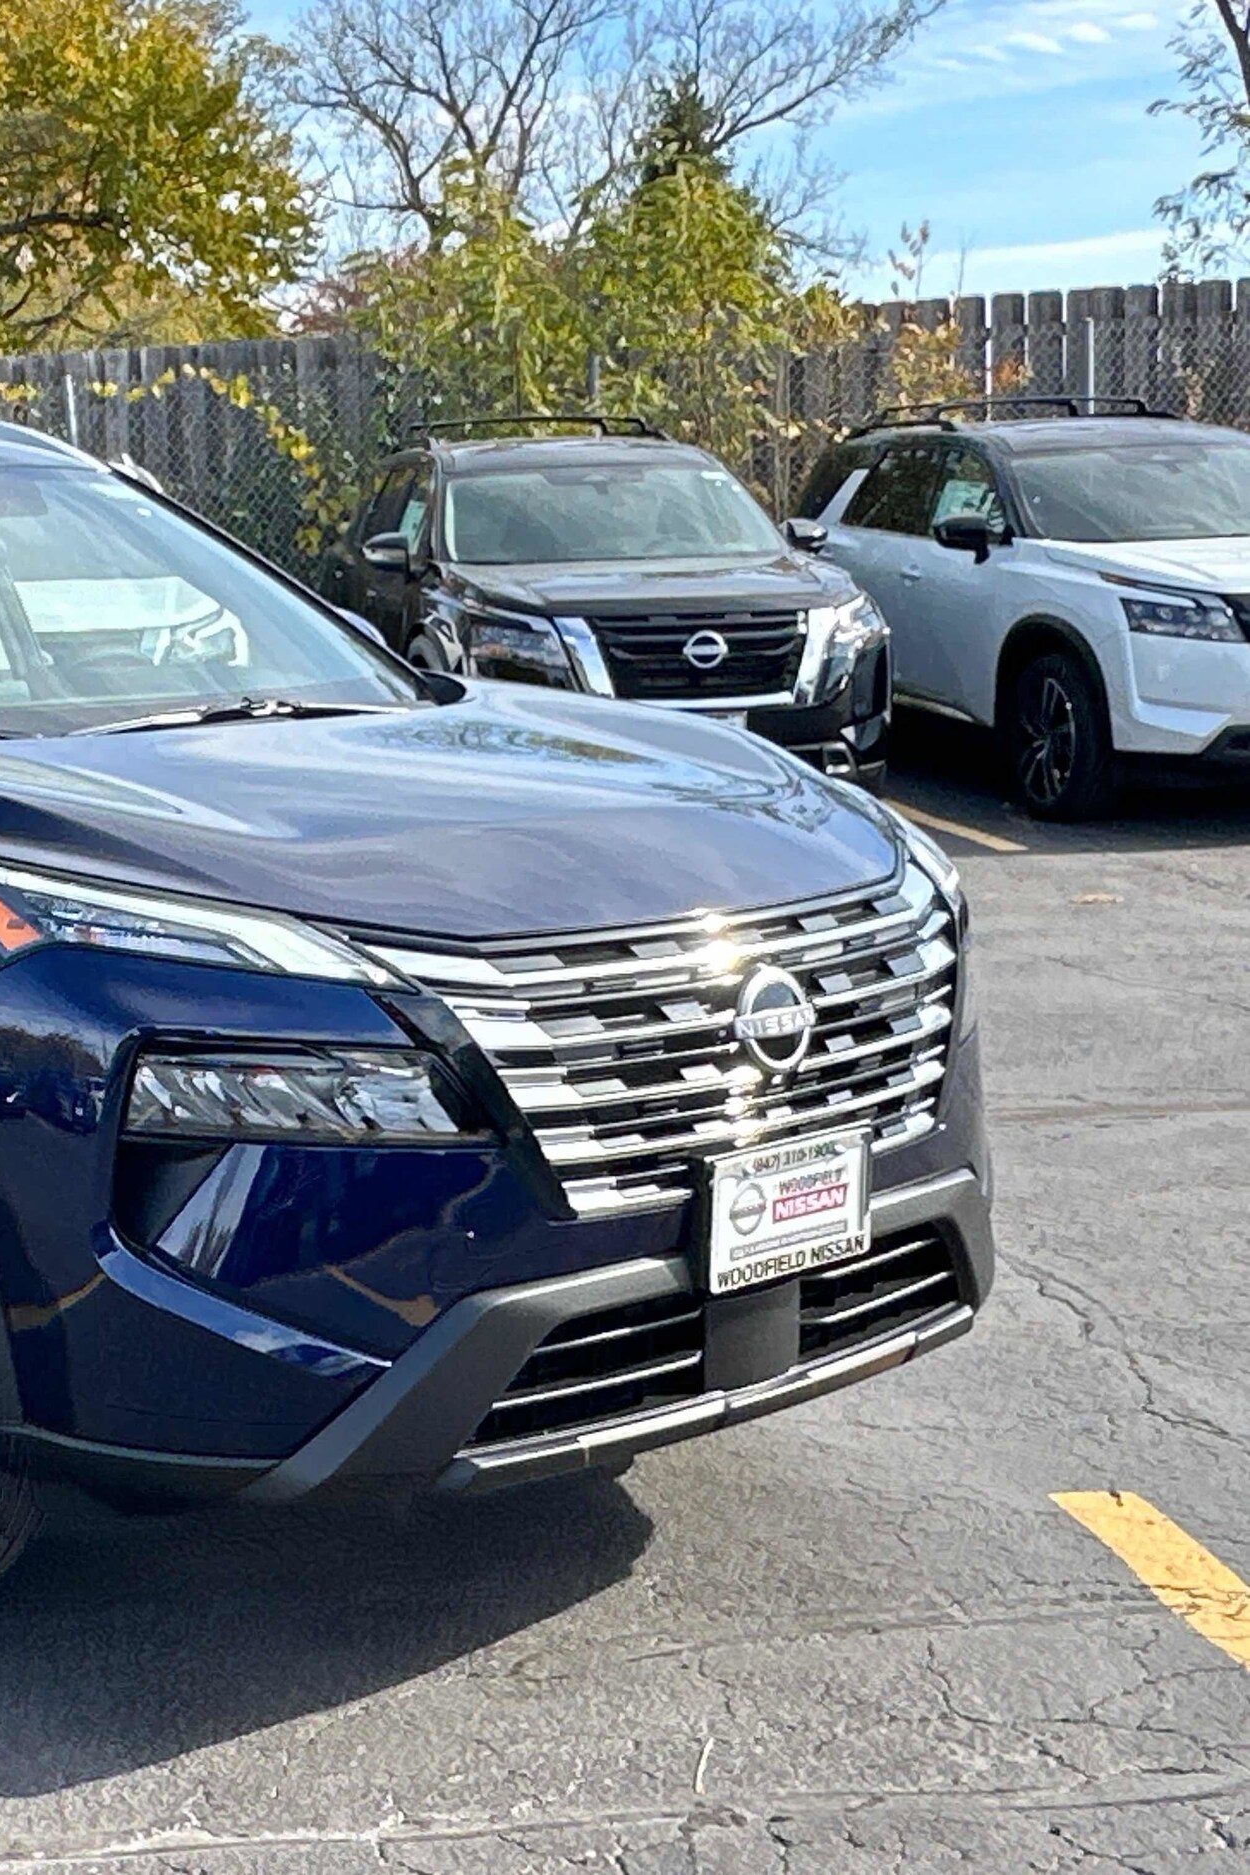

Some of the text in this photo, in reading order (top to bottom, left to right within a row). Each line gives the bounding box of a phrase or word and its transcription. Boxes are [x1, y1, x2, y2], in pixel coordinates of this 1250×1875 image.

[737, 1004, 814, 1039] NISSAN
[775, 1187, 845, 1220] NISSAN
[717, 1250, 806, 1288] WOODFIELD
[810, 1235, 865, 1264] NISSAN
